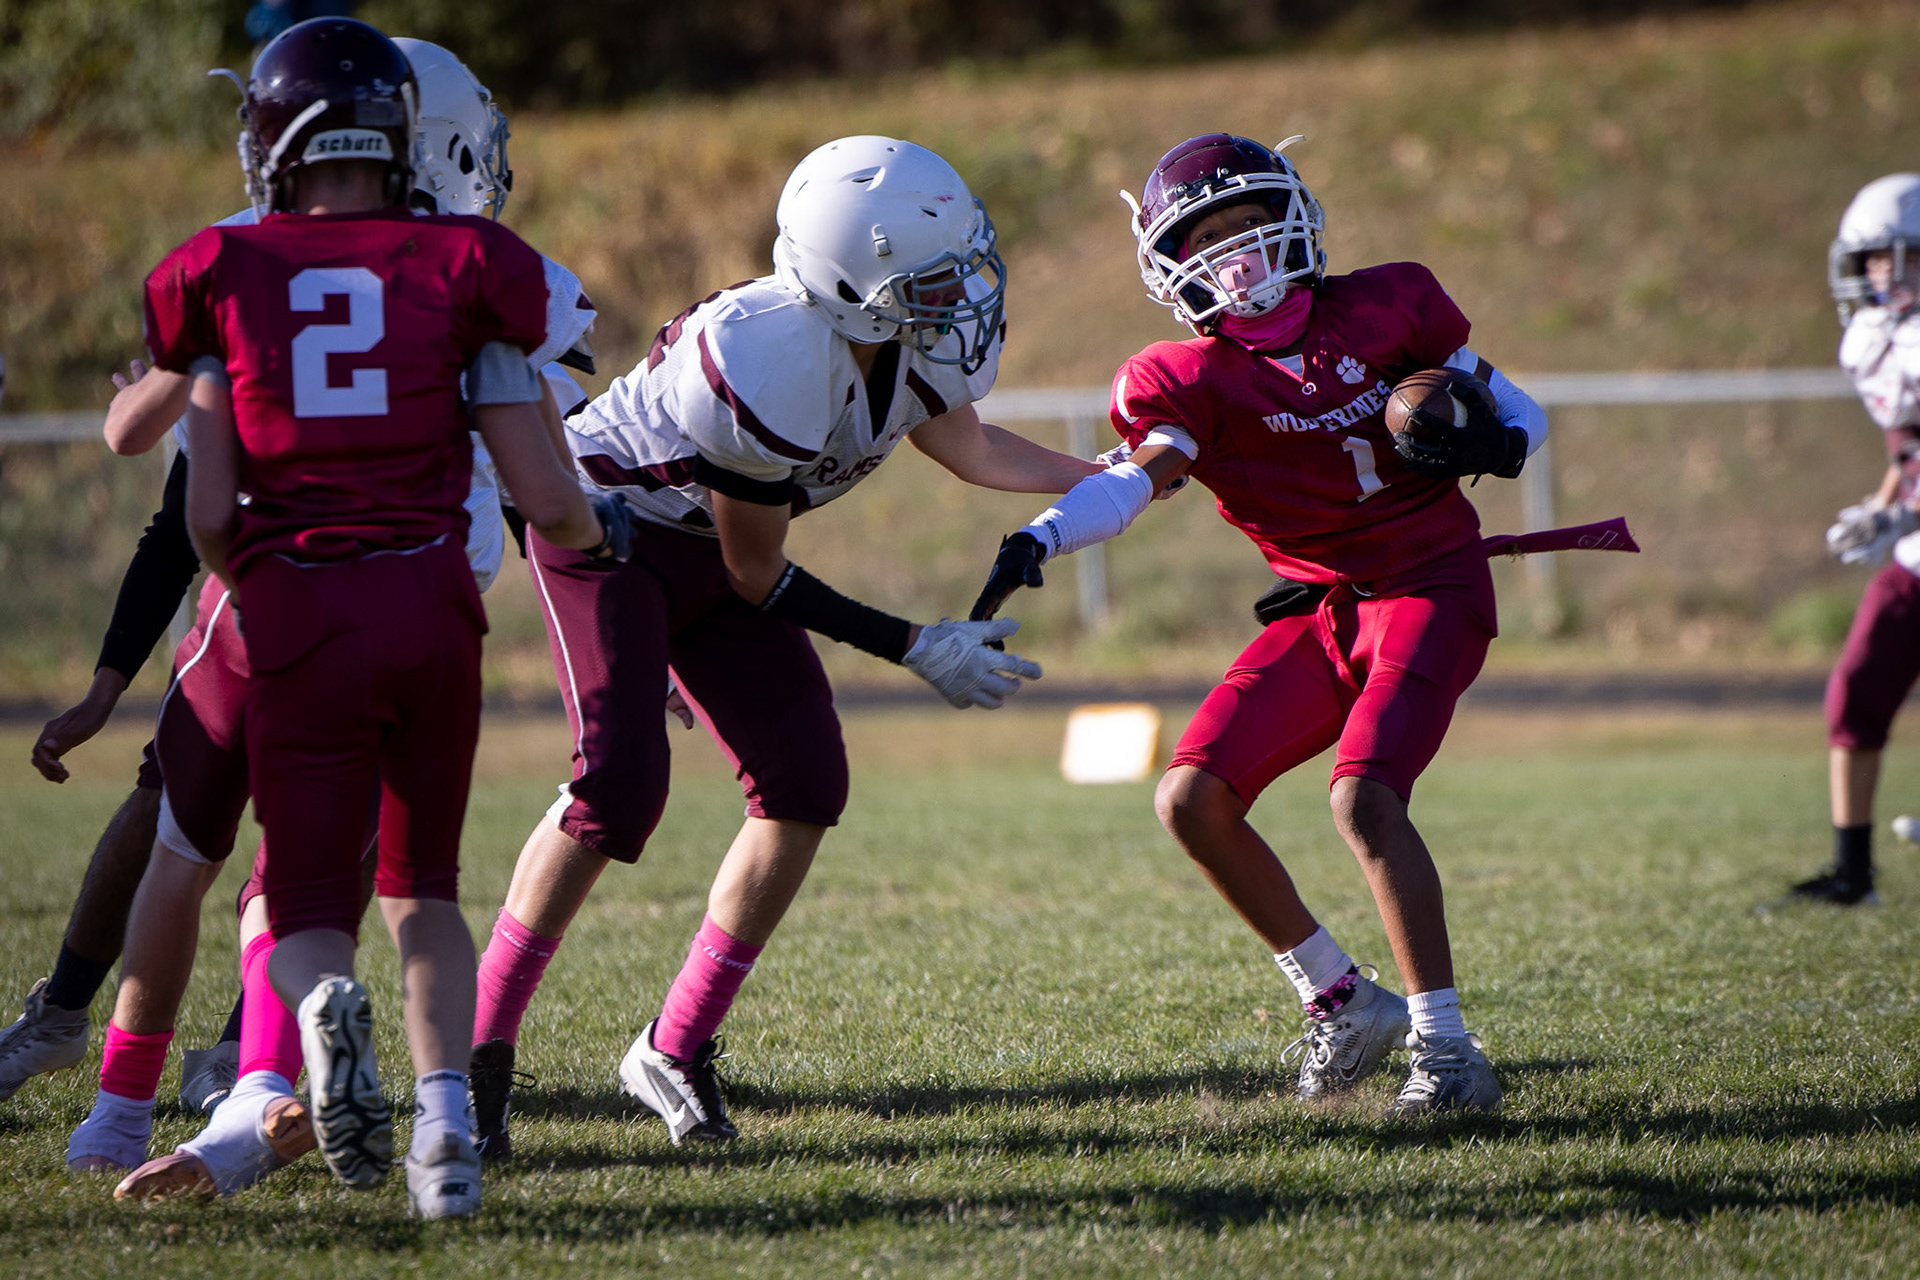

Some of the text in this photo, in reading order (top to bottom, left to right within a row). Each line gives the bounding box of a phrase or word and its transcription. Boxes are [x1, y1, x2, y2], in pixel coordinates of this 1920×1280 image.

[317, 134, 383, 152] schutt
[288, 266, 389, 418] 2
[1261, 379, 1393, 433] WOERINES
[808, 453, 885, 486] RAMS
[1341, 435, 1392, 503] 1
